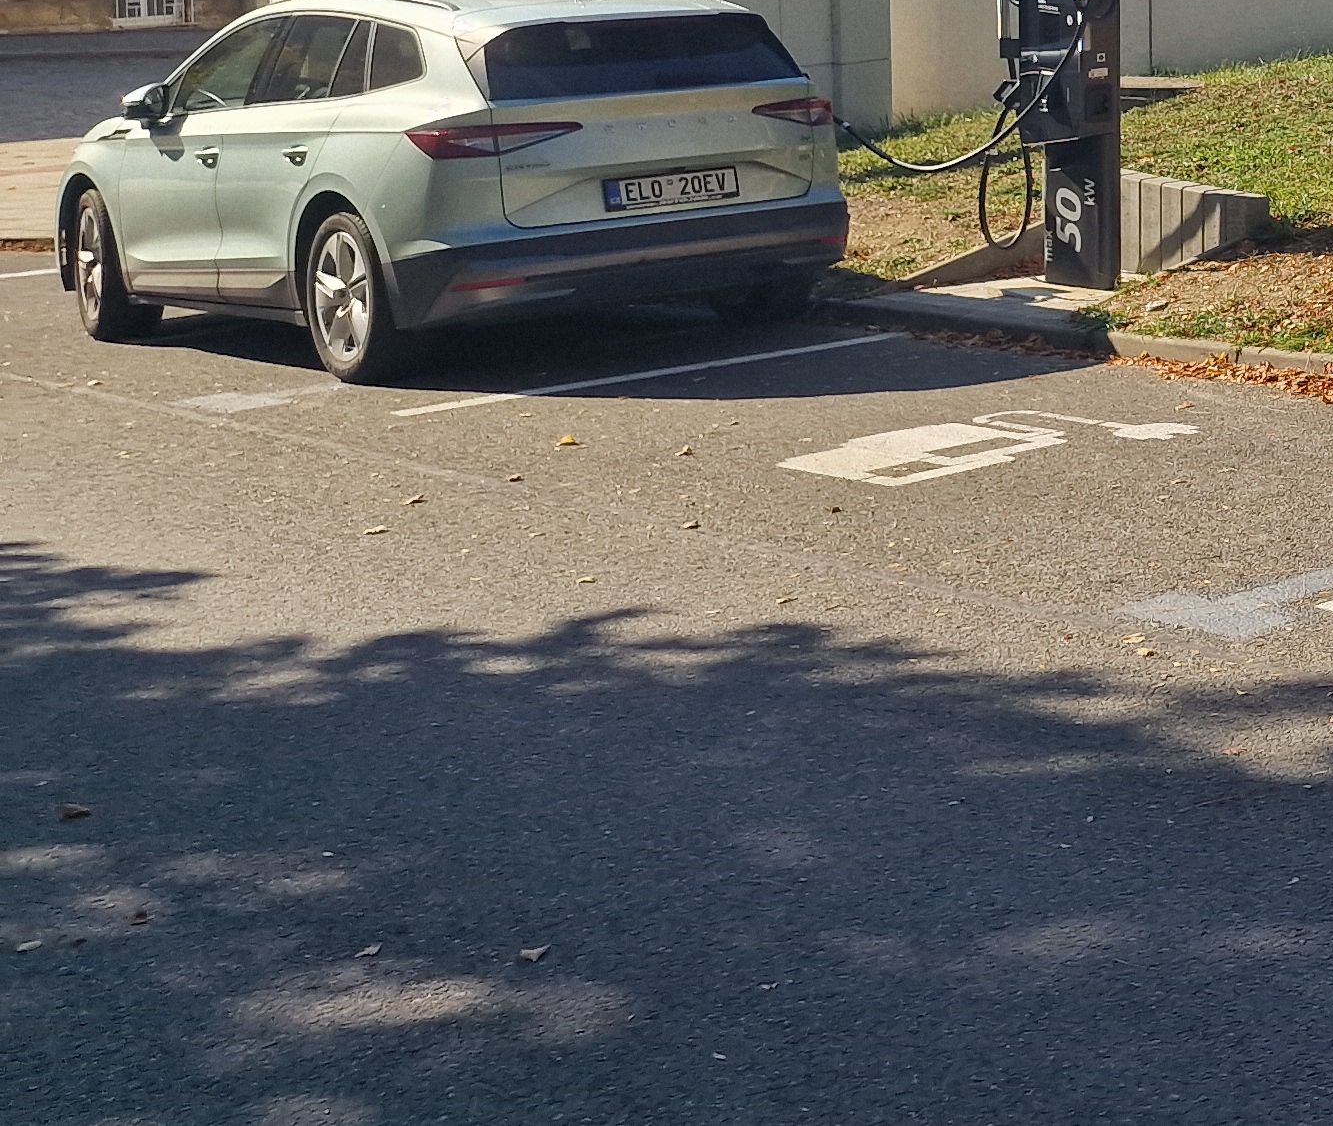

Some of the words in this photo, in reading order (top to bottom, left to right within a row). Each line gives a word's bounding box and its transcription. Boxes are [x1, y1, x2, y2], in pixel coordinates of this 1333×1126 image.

[679, 172, 726, 195] 20EV
[1083, 177, 1096, 206] kW
[1055, 187, 1082, 253] 50
